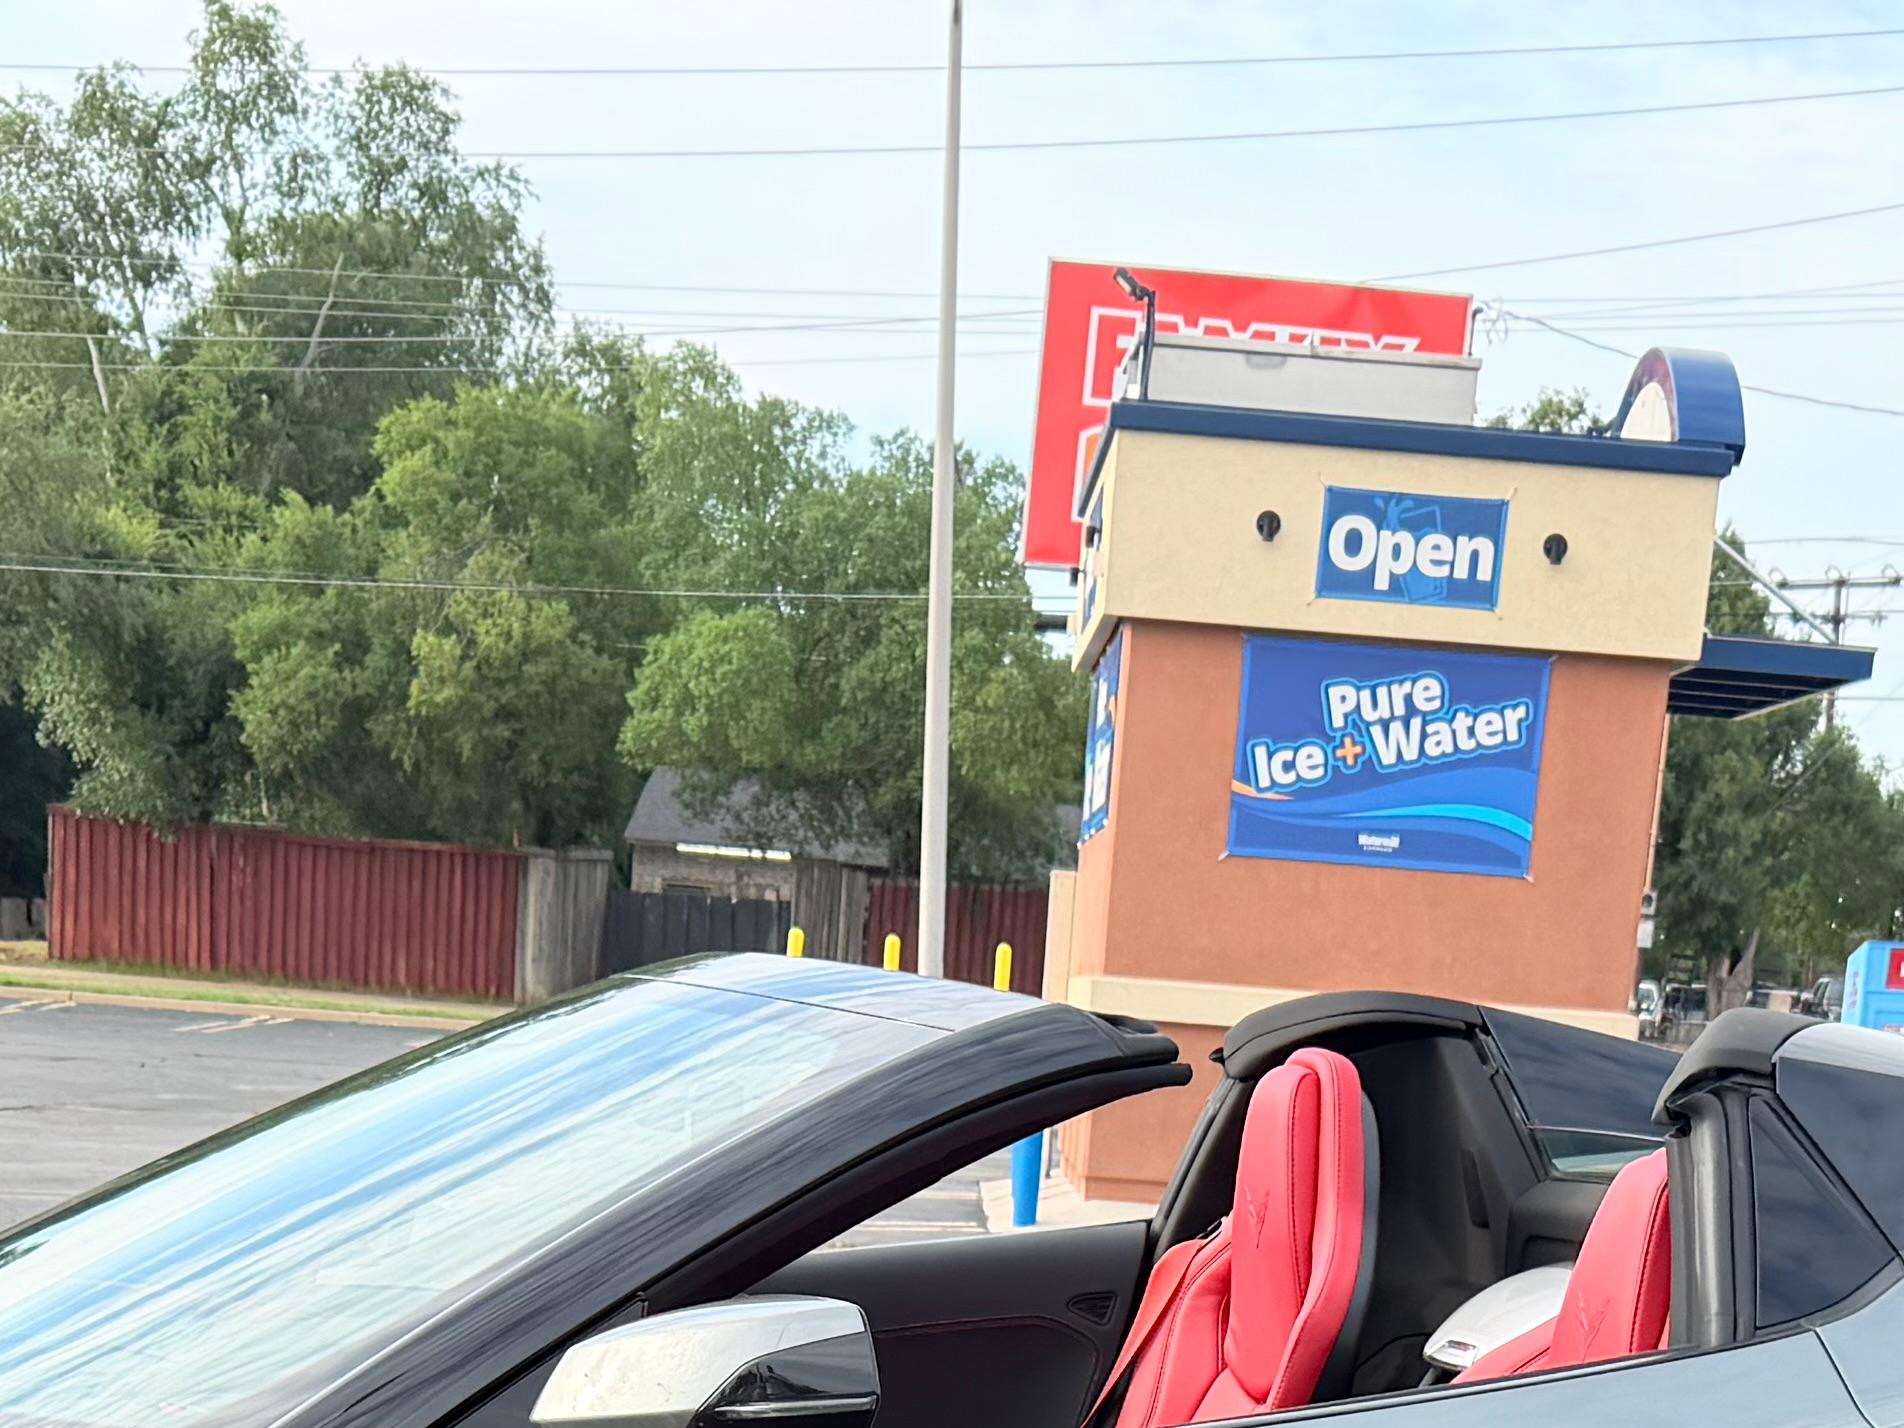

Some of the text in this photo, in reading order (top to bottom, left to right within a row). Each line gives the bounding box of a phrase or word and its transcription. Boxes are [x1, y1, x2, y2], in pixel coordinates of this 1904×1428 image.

[1329, 515, 1495, 590] Open
[1328, 677, 1442, 728] Pure
[1254, 745, 1325, 788] Ice
[1370, 704, 1527, 766] Water
